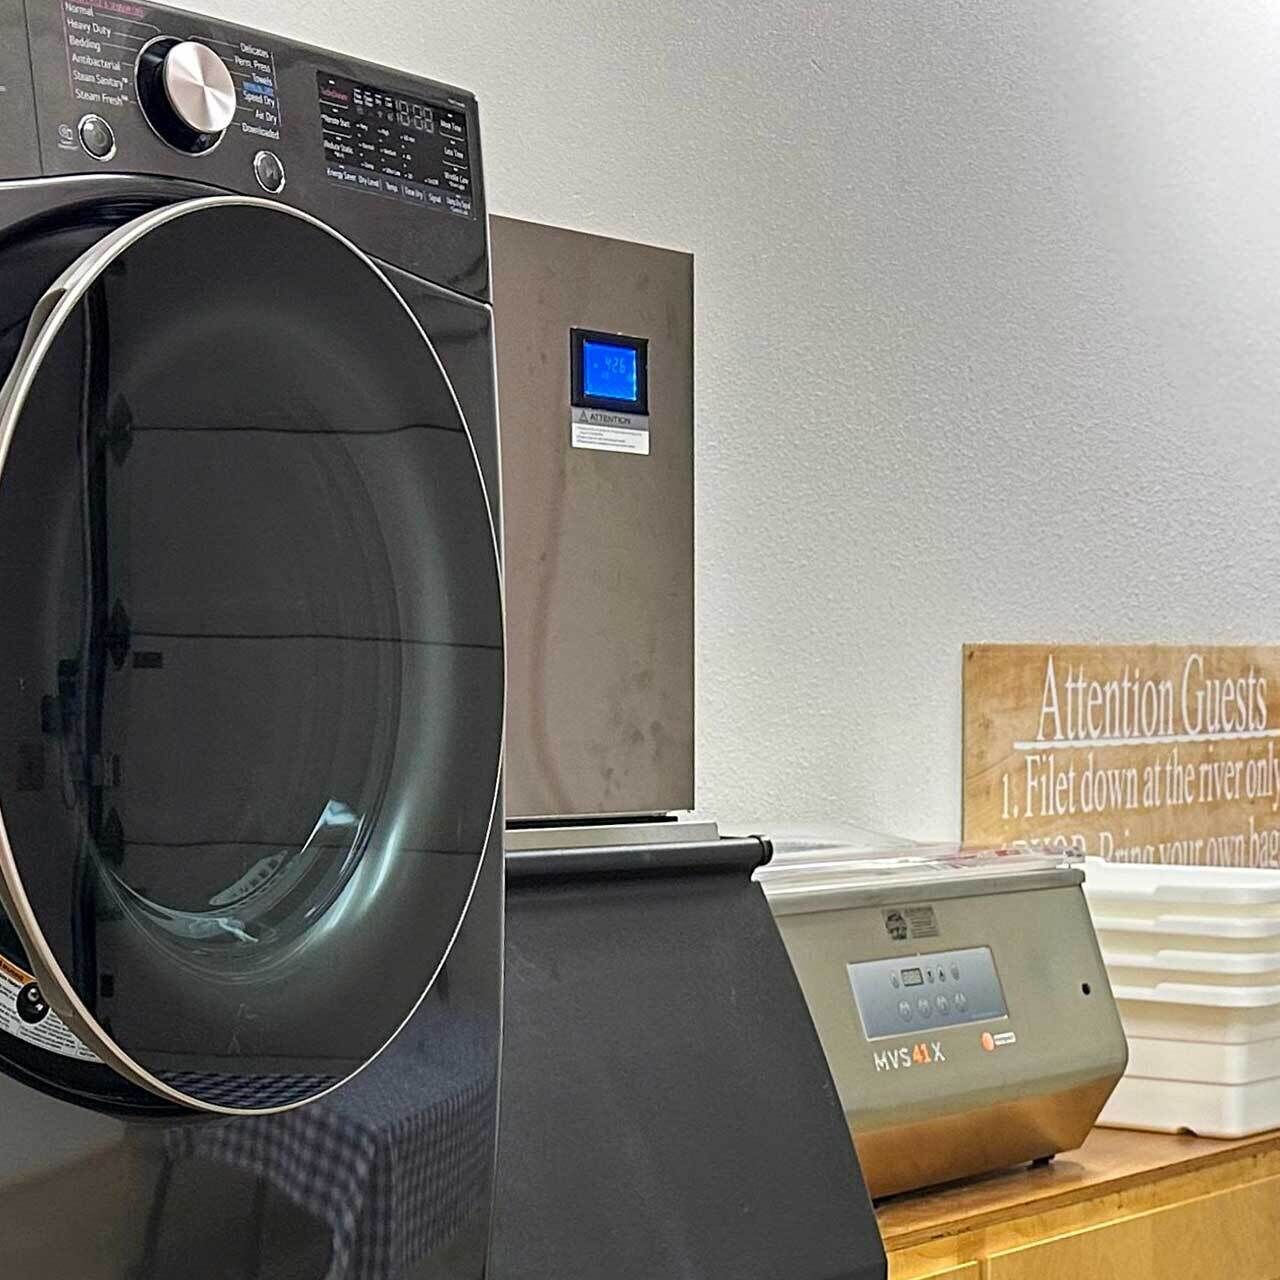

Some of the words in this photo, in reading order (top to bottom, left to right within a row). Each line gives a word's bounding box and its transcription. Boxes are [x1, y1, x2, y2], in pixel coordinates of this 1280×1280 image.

[92, 22, 111, 38] Duty
[590, 413, 632, 425] ATTENTION
[1036, 654, 1174, 741] Attention
[1181, 653, 1268, 736] Guests
[1001, 773, 1019, 819] 1.
[1024, 754, 1076, 817] Filet
[1080, 751, 1138, 813] down
[1143, 761, 1163, 808] at
[1163, 747, 1196, 806] the
[1198, 745, 1243, 802] river
